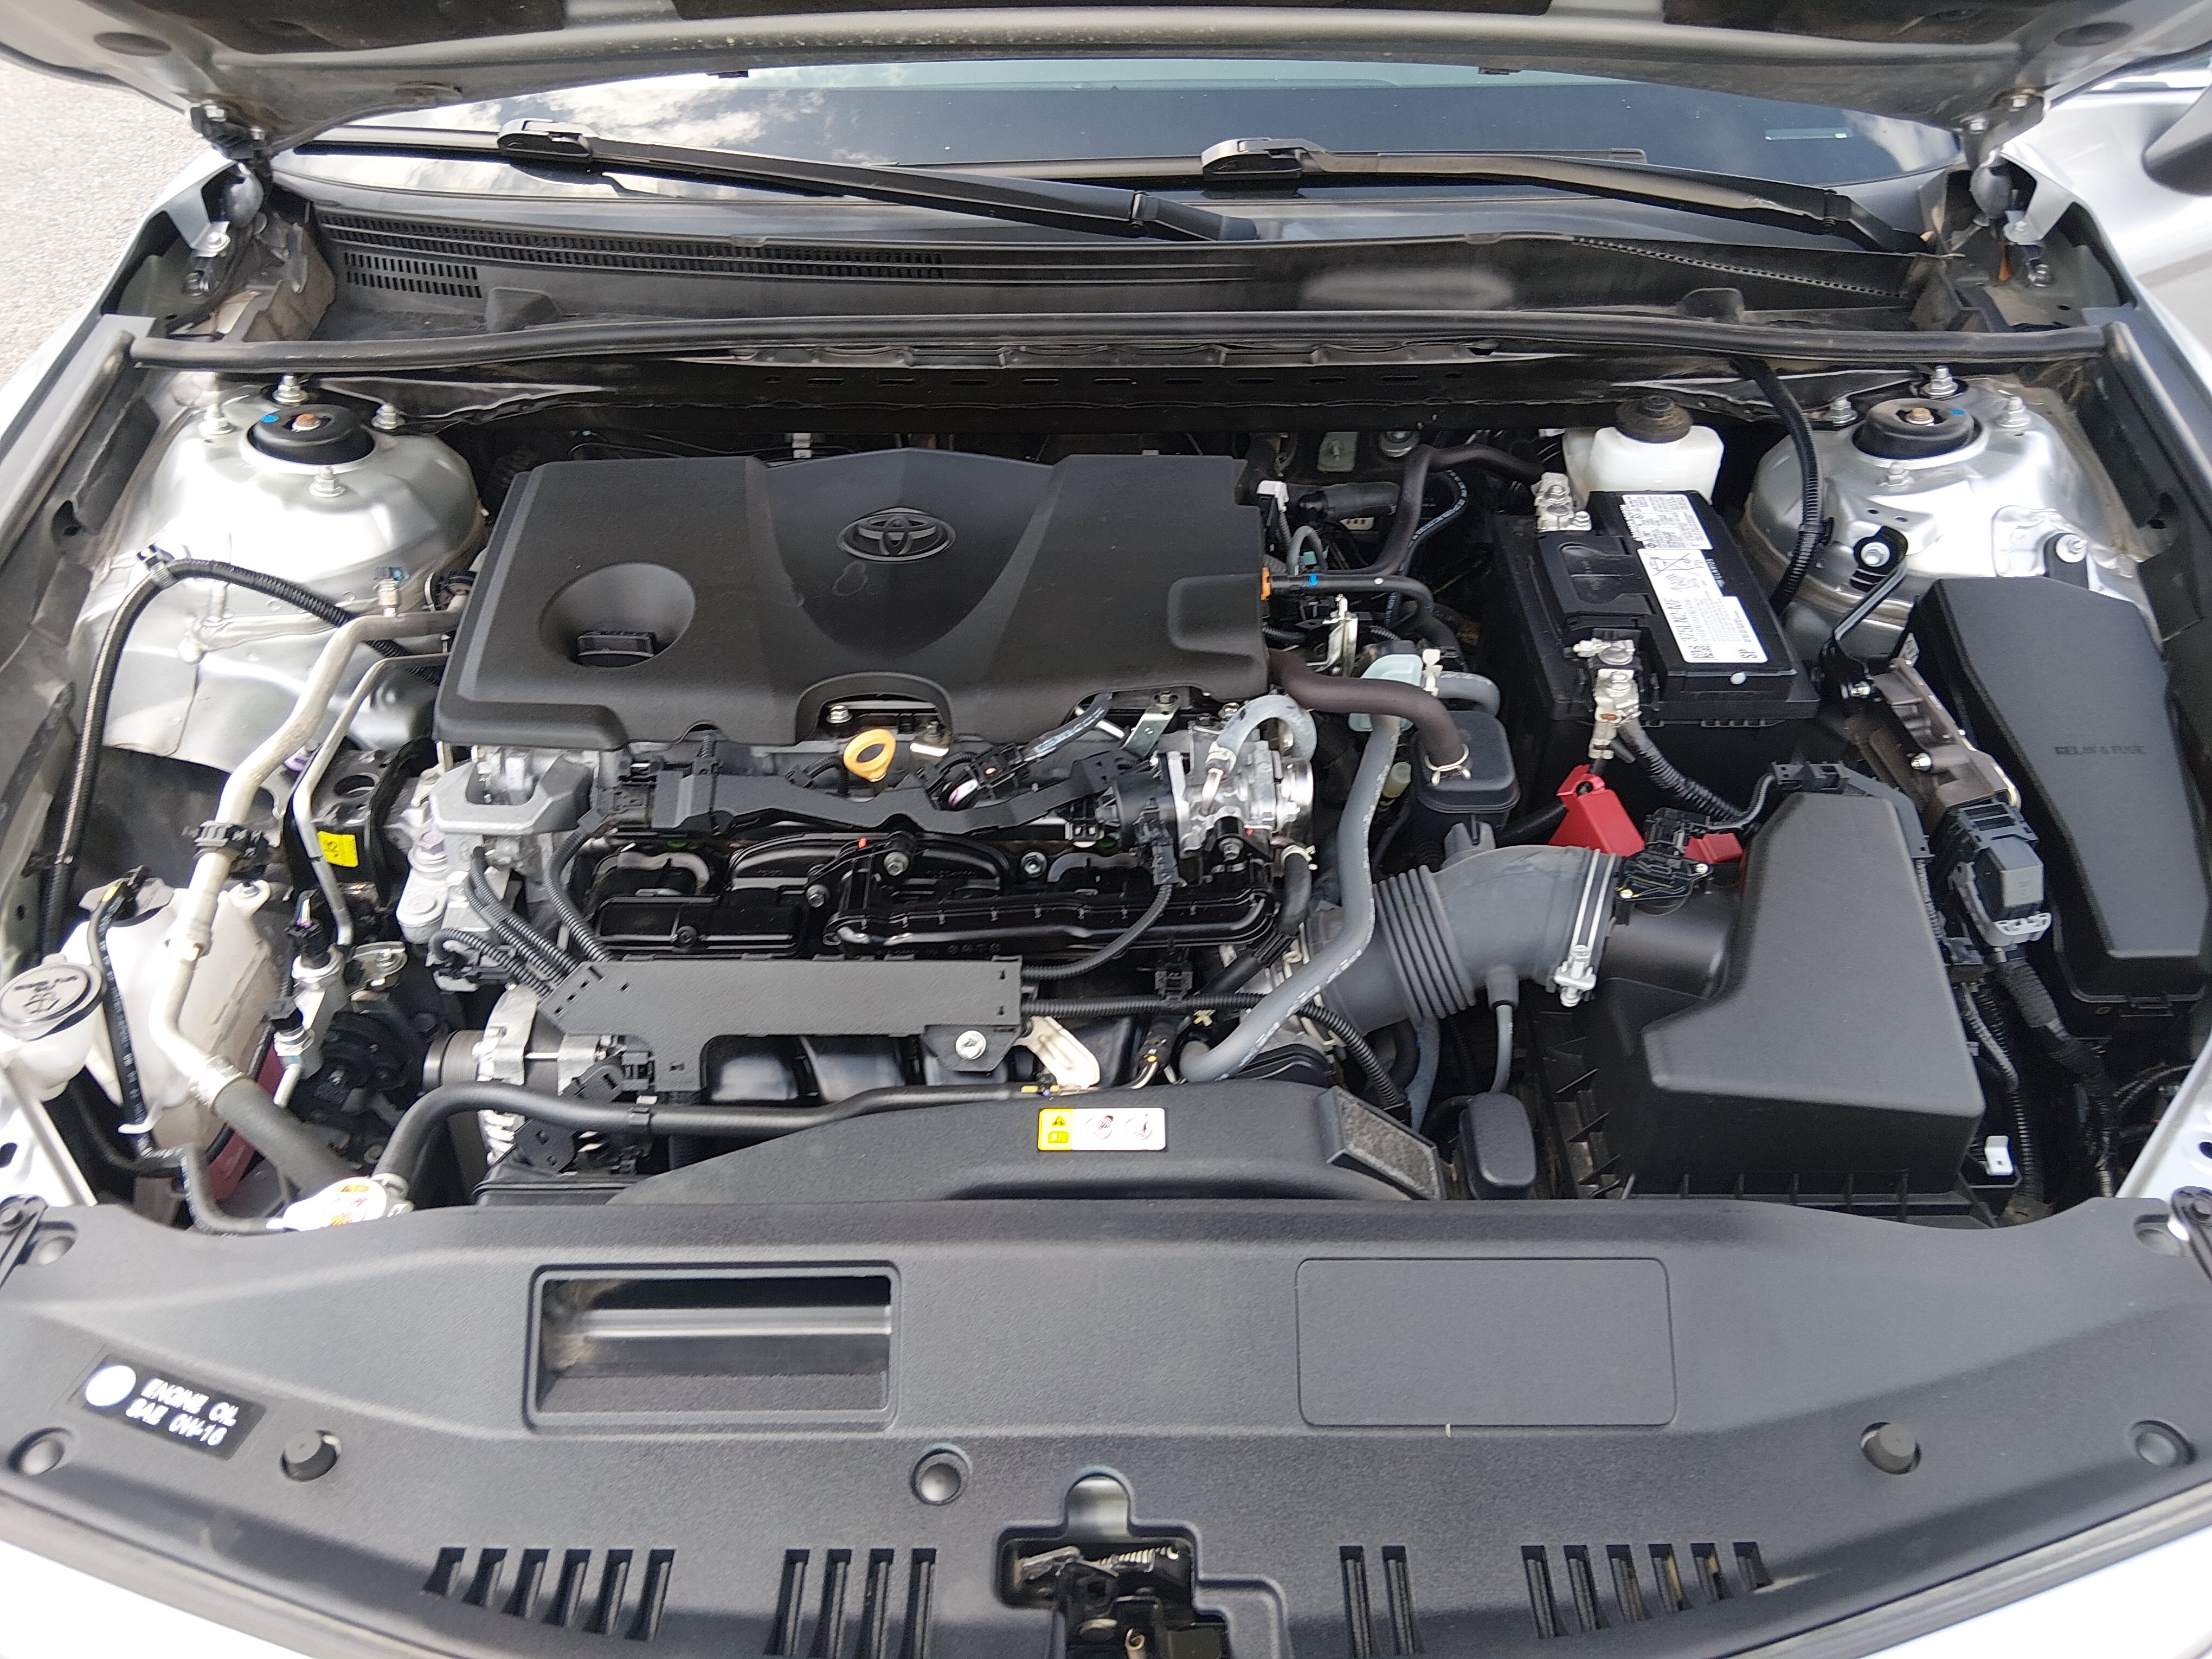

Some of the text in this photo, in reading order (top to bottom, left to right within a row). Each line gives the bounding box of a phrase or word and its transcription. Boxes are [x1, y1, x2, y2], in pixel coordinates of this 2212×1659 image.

[1663, 597, 1698, 642] 375LN2-MF
[1738, 649, 1759, 659] SP
[125, 1398, 228, 1446] SAE 0W-16
[140, 1378, 239, 1427] ENGINE OIL
